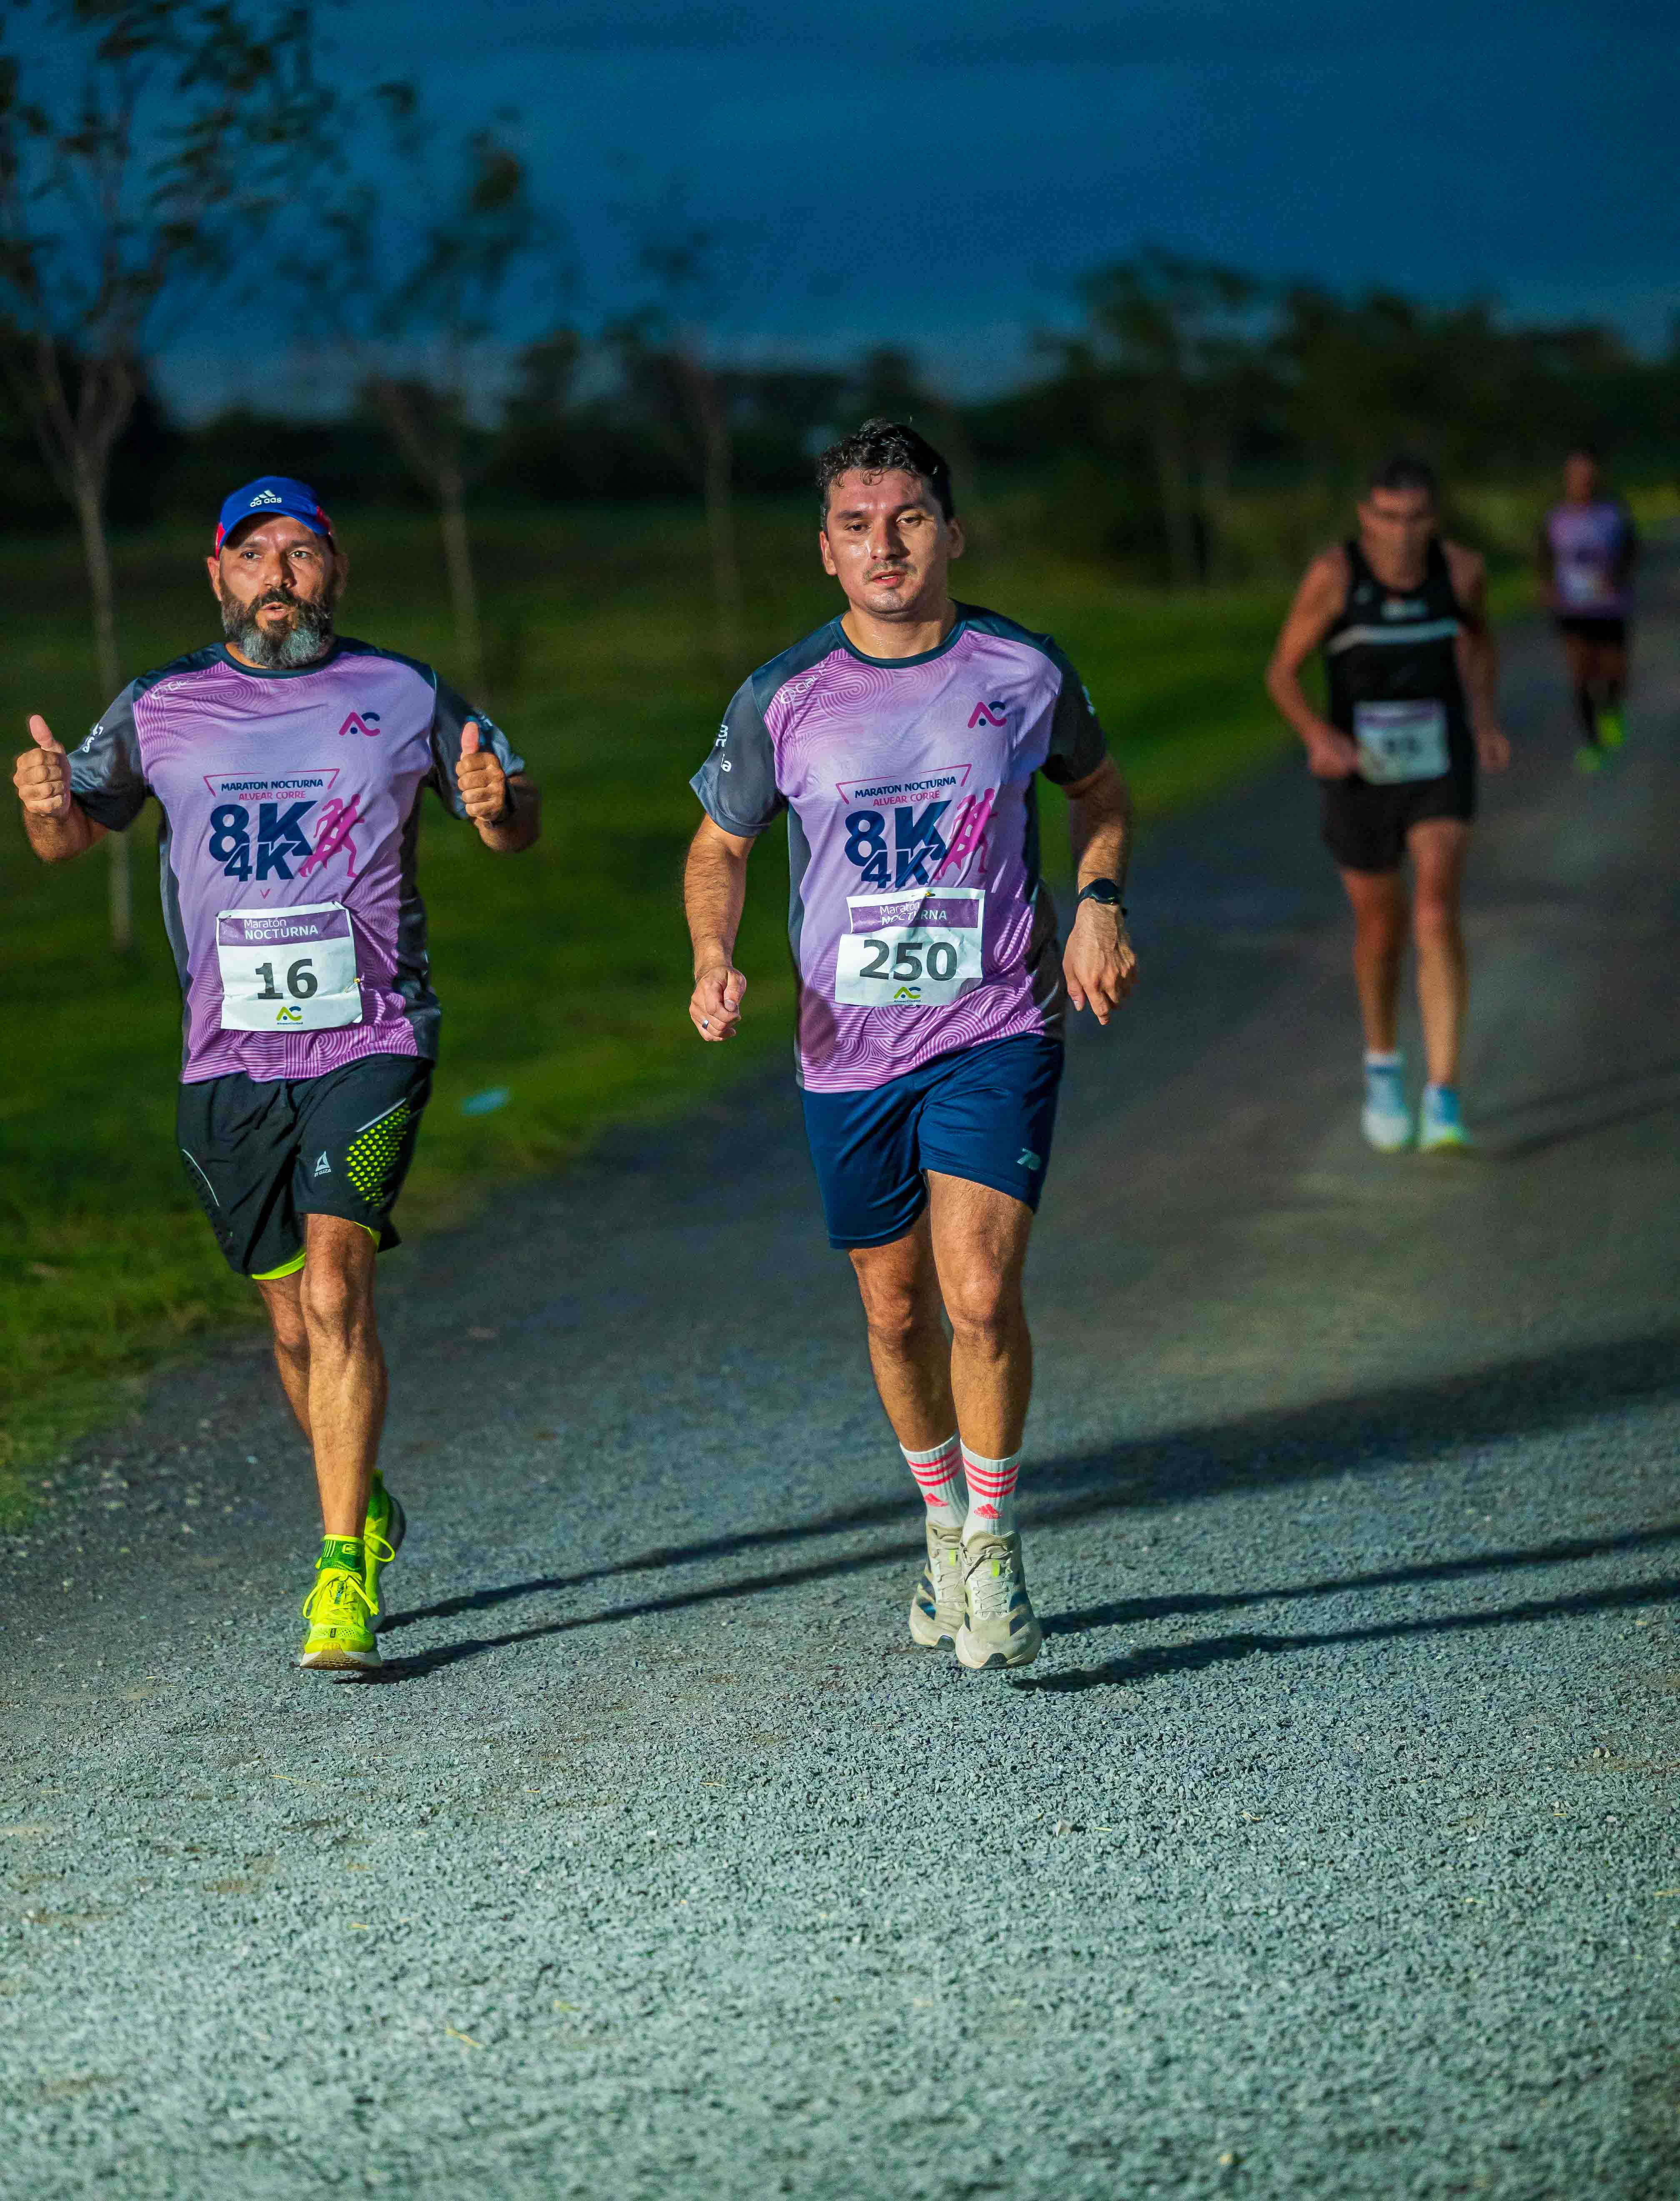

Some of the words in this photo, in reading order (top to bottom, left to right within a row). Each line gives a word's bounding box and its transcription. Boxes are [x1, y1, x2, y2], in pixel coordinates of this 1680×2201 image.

[250, 498, 282, 507] addas
[338, 712, 380, 736] AC
[221, 781, 268, 791] MARATON
[271, 779, 323, 790] NOCTURNA
[238, 792, 273, 801] ALVEAR
[275, 791, 306, 799] CORRE
[855, 784, 902, 799] MARATON
[904, 776, 957, 792] NOCTURNA
[873, 795, 907, 807] ALVEAR
[910, 790, 940, 802] CORRE
[209, 800, 318, 862] 8K
[844, 799, 952, 867] 8K
[223, 842, 295, 882] 4K
[861, 846, 936, 889] 4K
[244, 917, 287, 929] Maratón
[245, 925, 318, 940] NOCTURNA
[859, 939, 958, 982] 250
[255, 958, 318, 1000] 16
